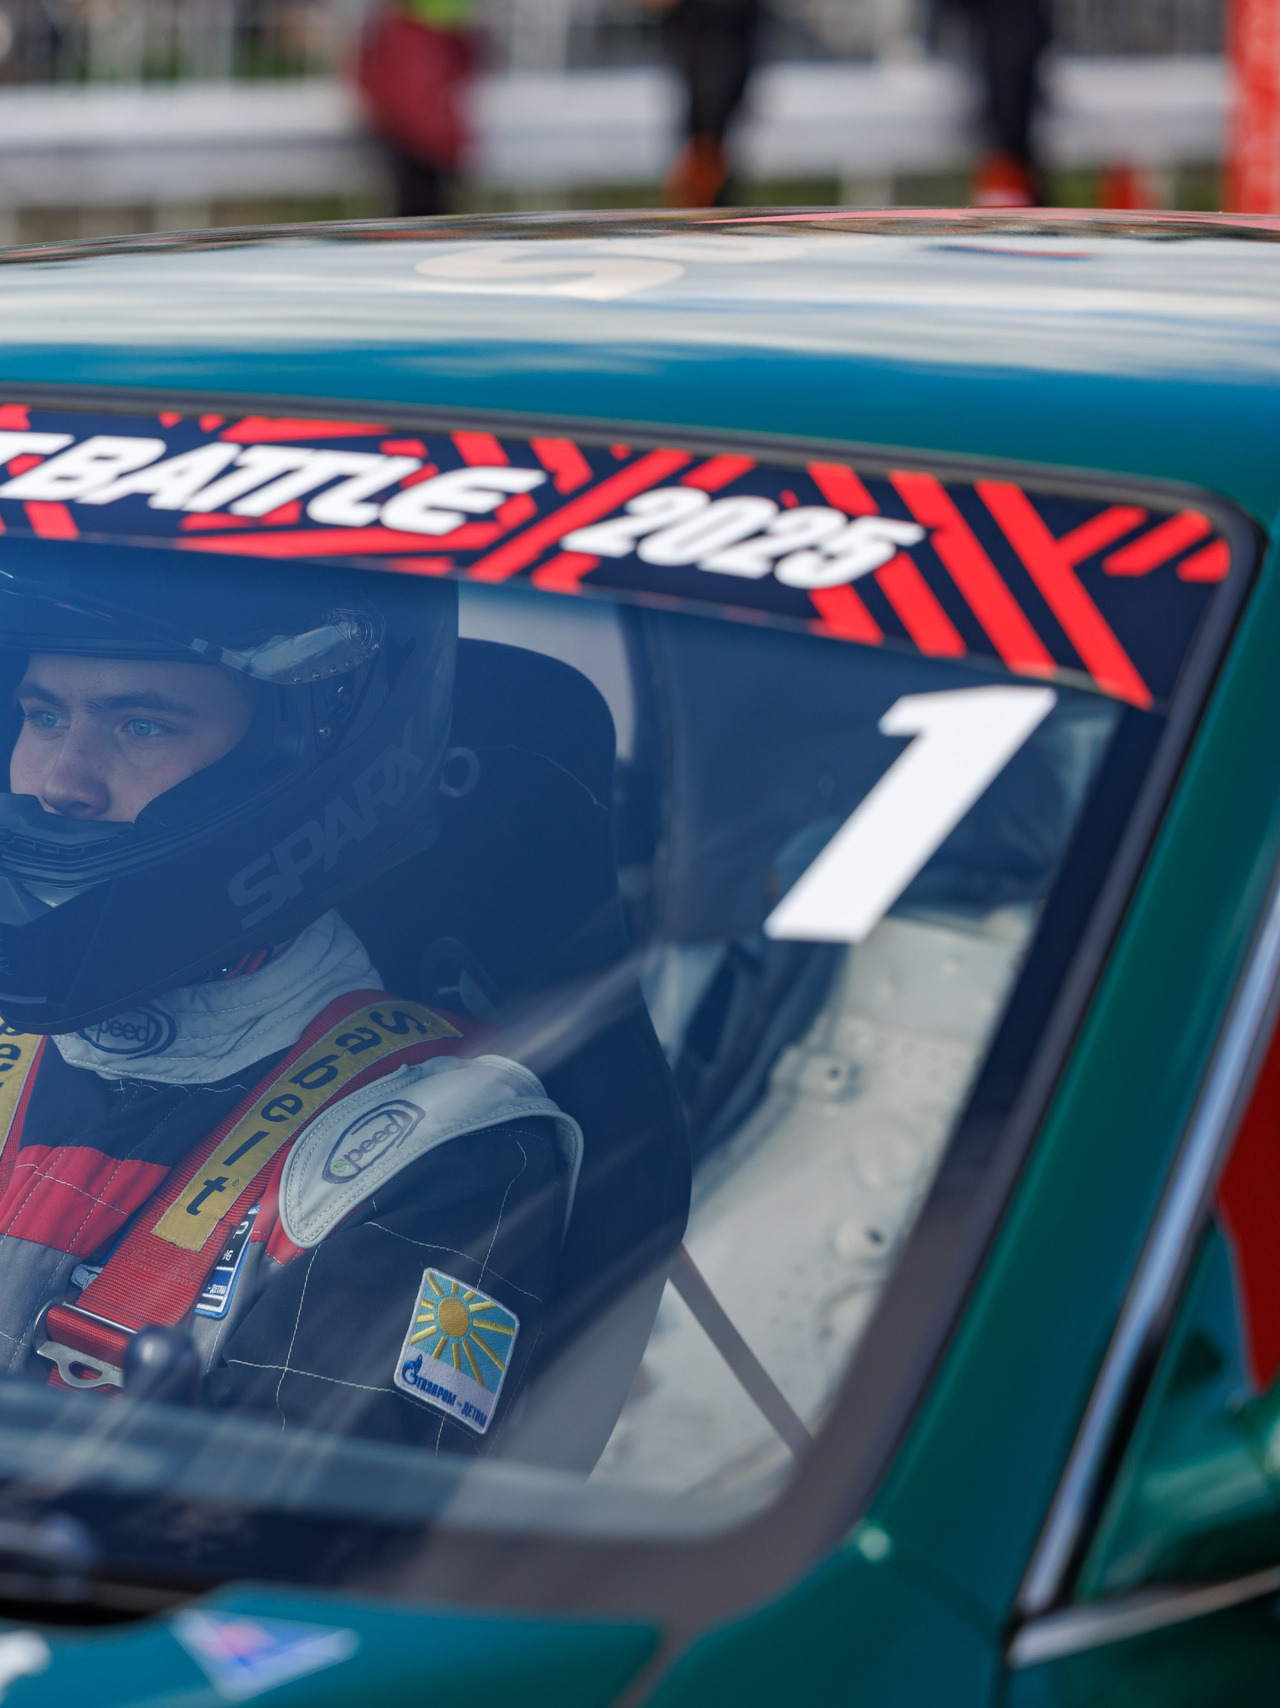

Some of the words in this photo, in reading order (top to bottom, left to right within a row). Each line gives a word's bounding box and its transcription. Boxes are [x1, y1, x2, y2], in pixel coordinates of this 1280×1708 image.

[561, 486, 926, 590] 2025
[765, 684, 1058, 943] 1
[87, 1014, 152, 1043] peed
[186, 1010, 428, 1217] Sabelt
